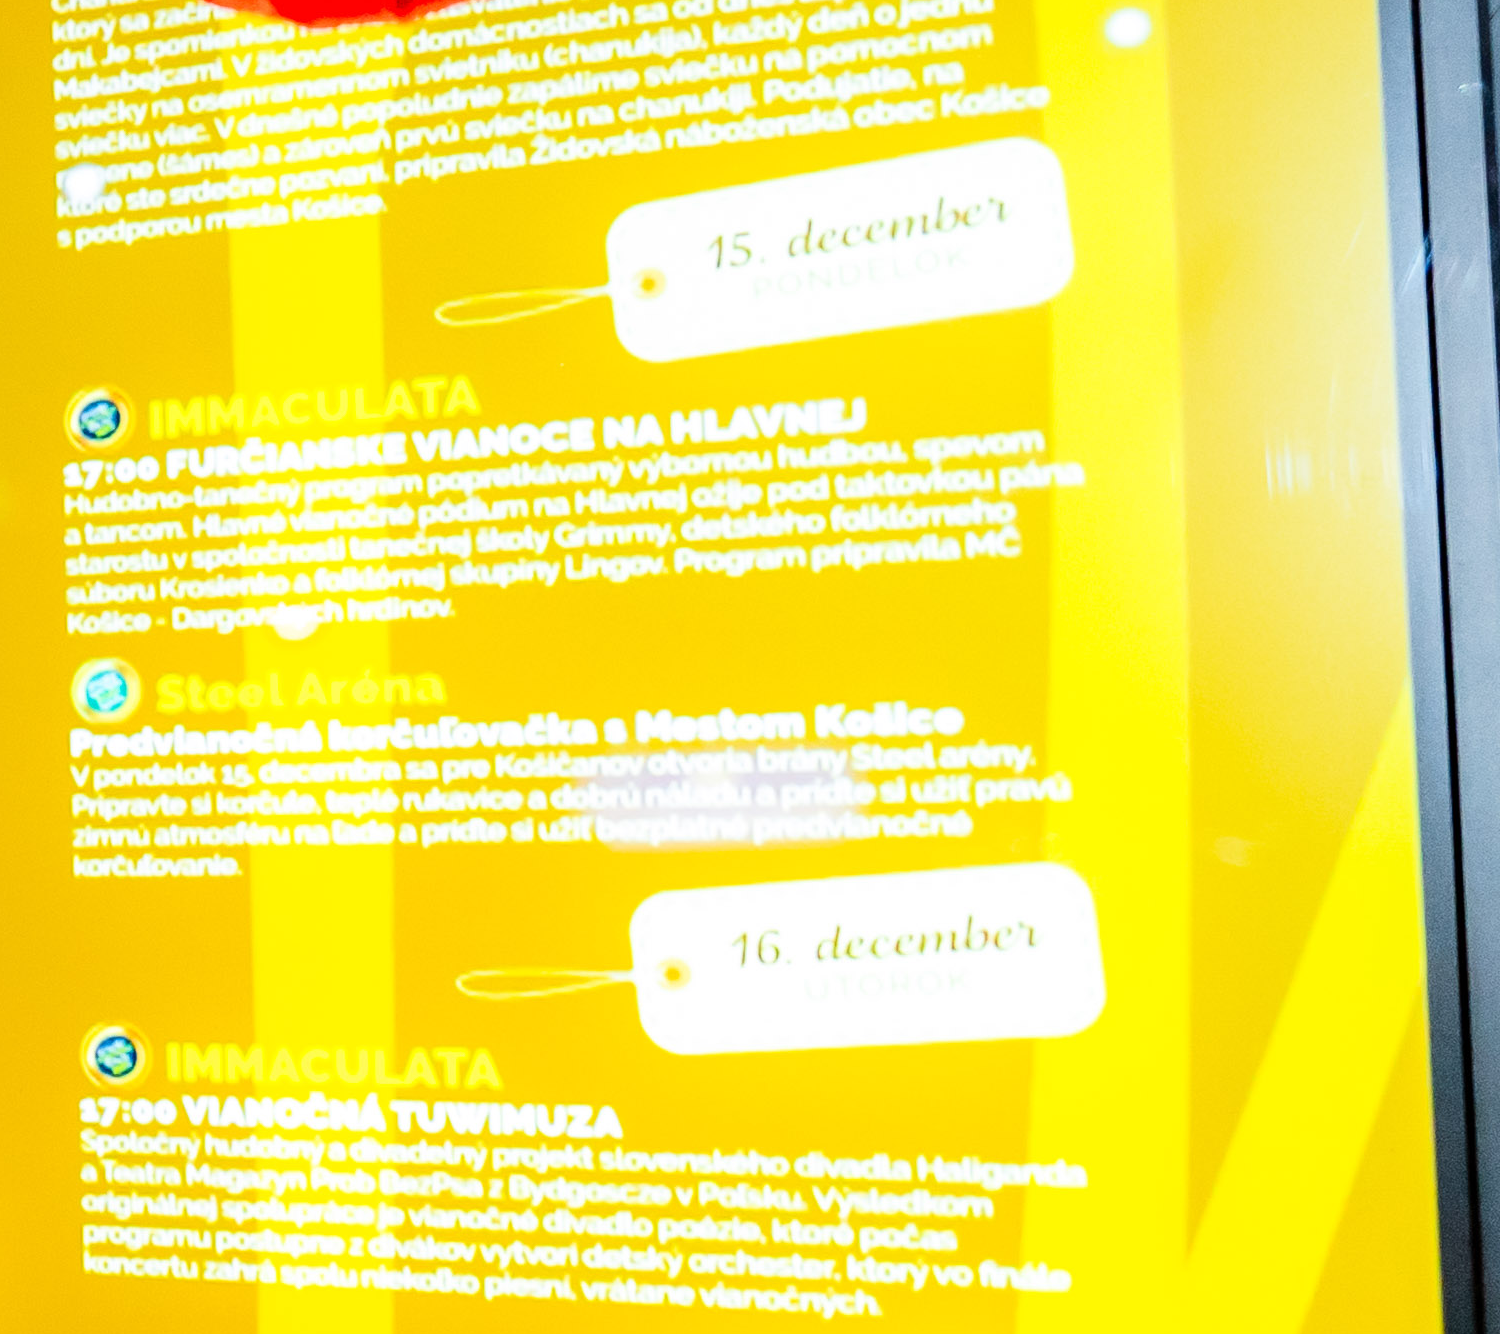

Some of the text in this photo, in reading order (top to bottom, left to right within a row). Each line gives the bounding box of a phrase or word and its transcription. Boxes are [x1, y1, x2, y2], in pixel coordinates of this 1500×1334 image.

[706, 198, 1012, 272] 15. december
[148, 376, 482, 438] IMMACULATA
[64, 398, 866, 489] 17:00 FURČIANSKE VIANOCE NA HLAVNEJ
[157, 666, 449, 713] Steel Aréna
[70, 701, 963, 757] Predvianočná korčuľovačka s Mestom Košice
[731, 914, 1041, 970] 16. december
[165, 1043, 504, 1090] IMMACULATA
[79, 1092, 623, 1139] 17:00 VIANOČNÁ TUWIMUZA
